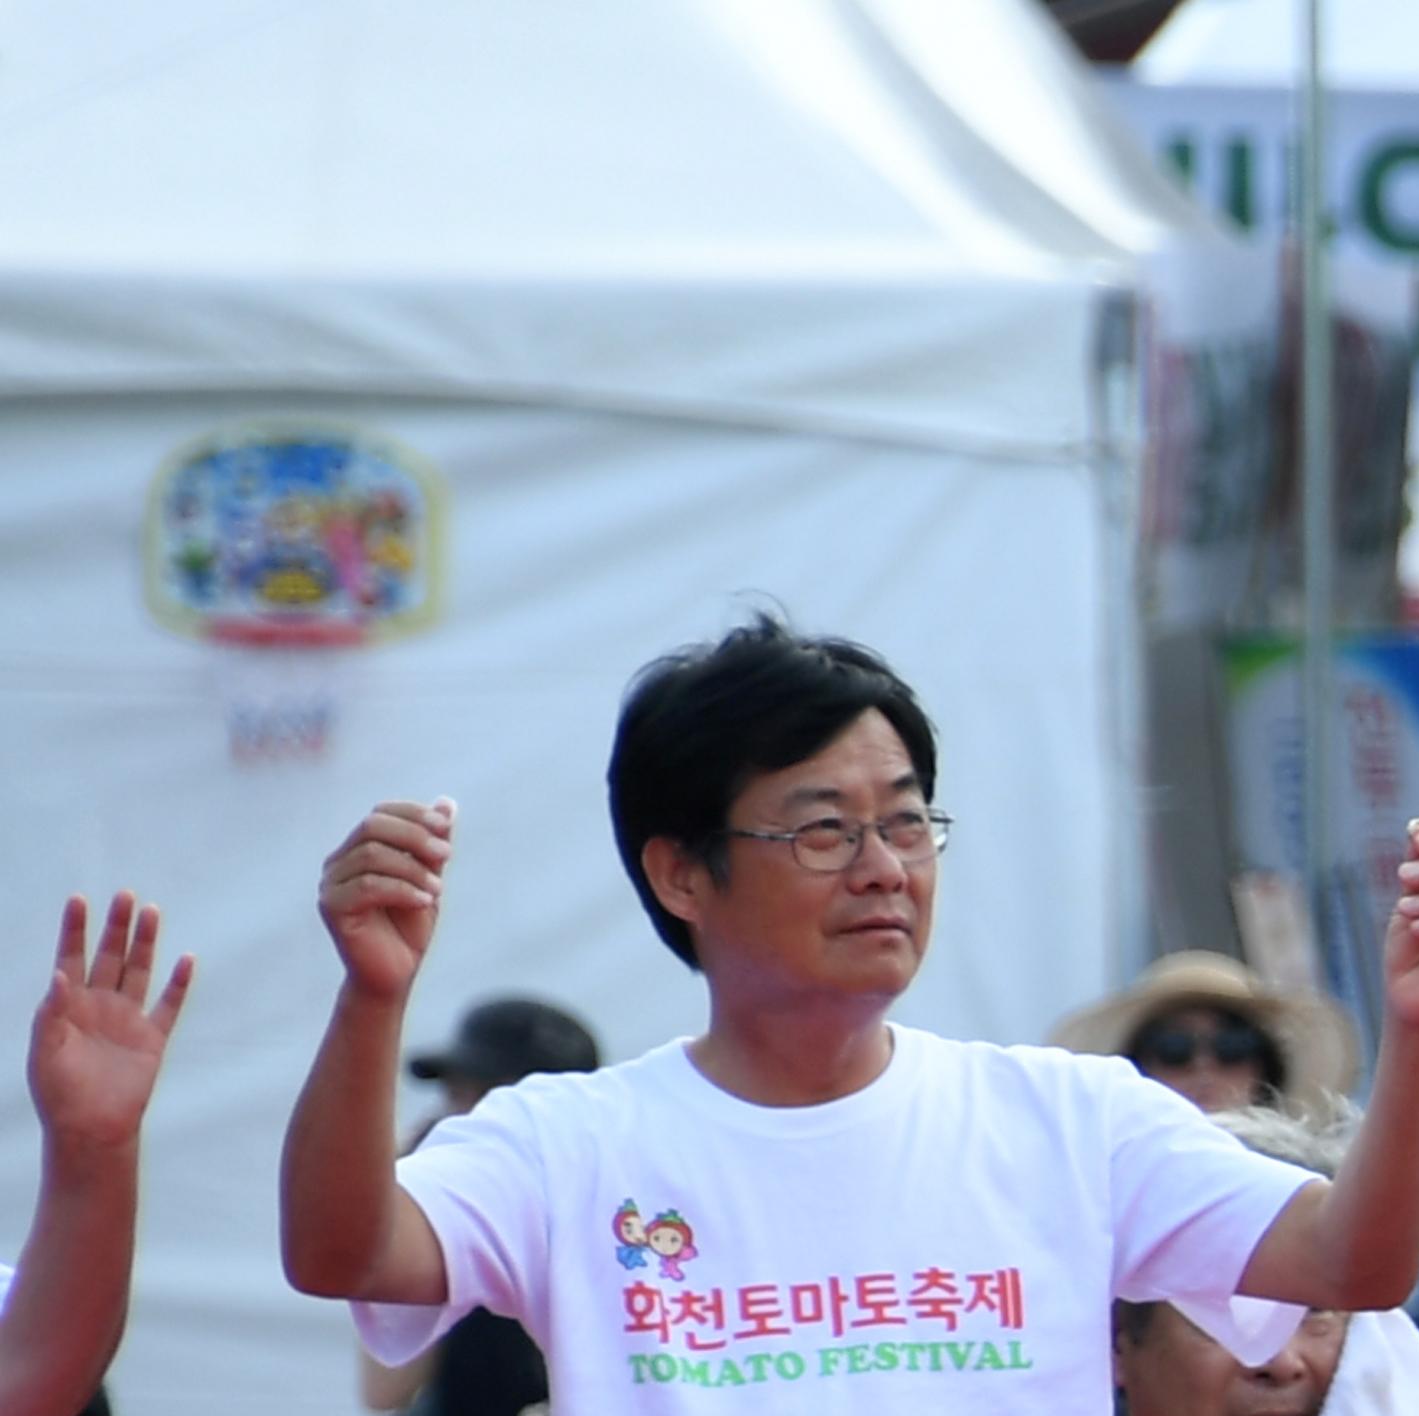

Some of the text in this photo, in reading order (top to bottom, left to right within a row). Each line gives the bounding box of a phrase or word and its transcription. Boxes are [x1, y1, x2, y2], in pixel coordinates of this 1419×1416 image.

[622, 1266, 1025, 1351] 화천토마토축제
[628, 1341, 1033, 1387] TOMATO FESTIVAL
